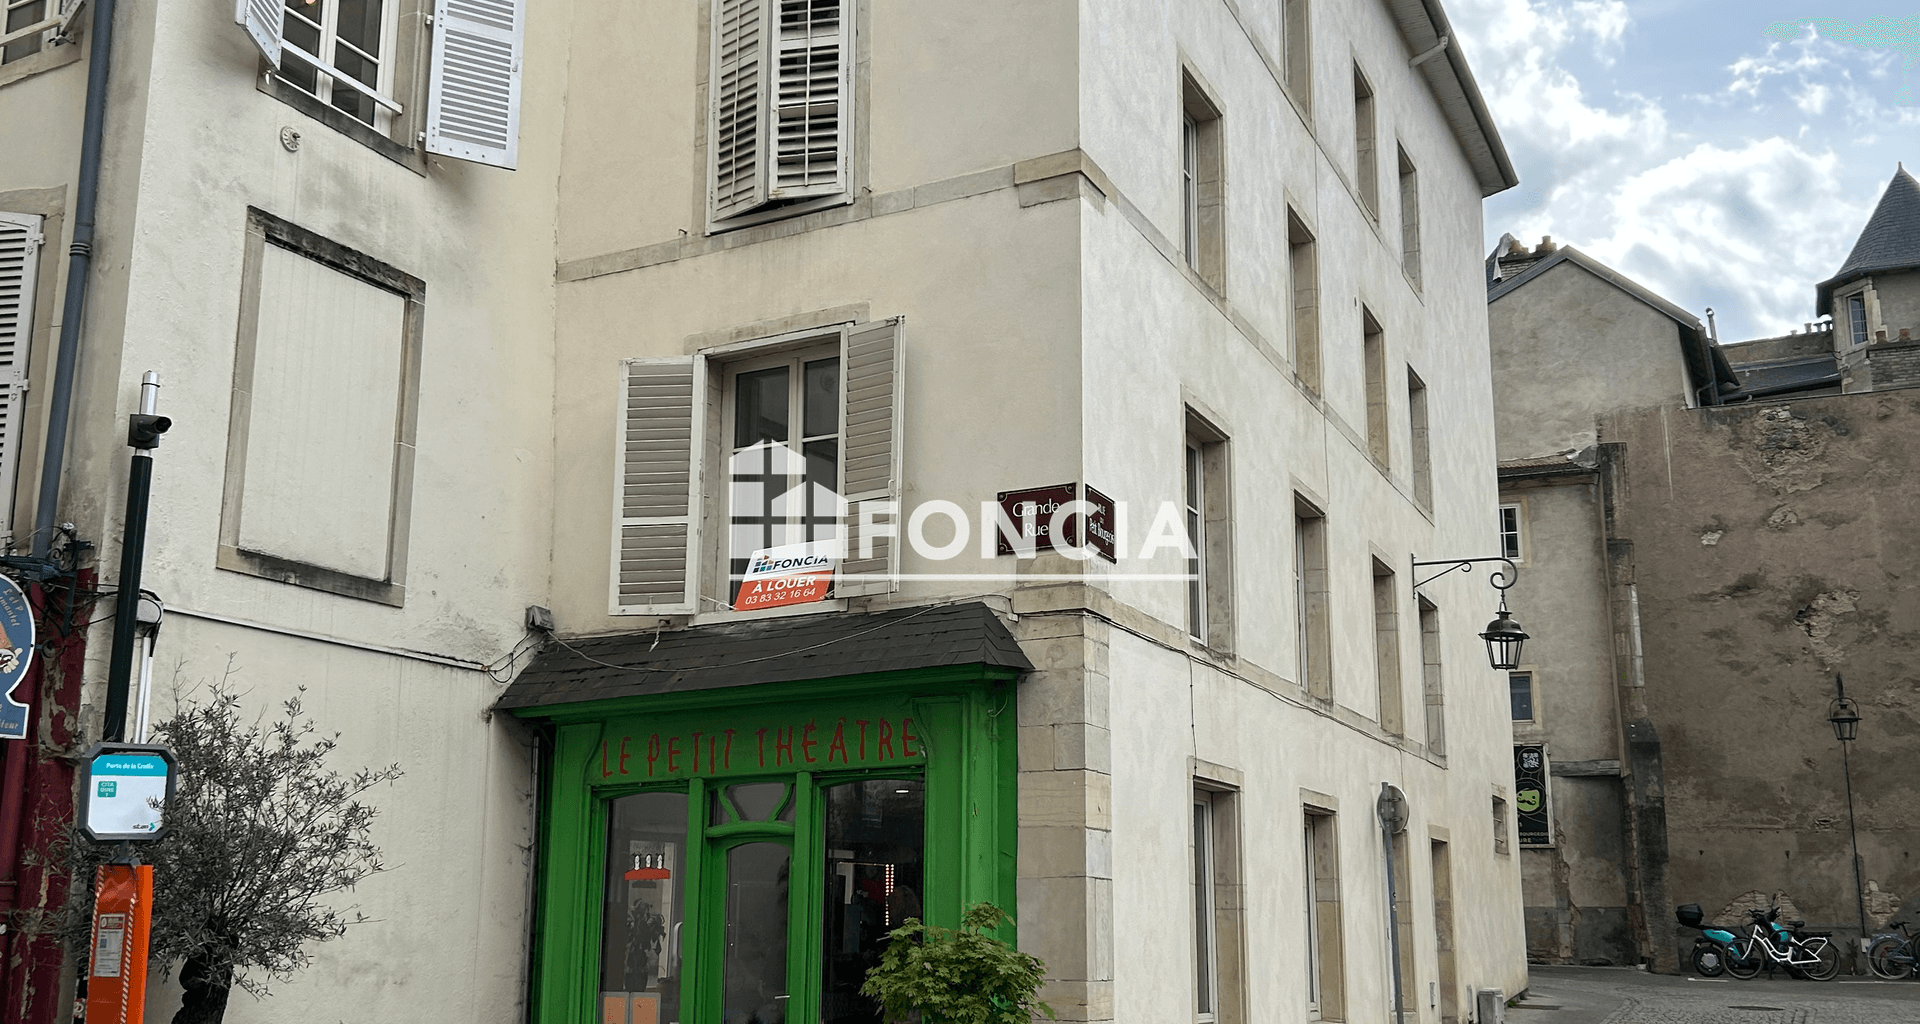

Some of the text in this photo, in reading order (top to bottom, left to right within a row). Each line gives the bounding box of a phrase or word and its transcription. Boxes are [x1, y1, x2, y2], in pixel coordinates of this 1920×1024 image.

[1012, 498, 1060, 518] Grande
[1024, 522, 1049, 537] Rue
[772, 555, 828, 570] FONCIA
[752, 576, 817, 594] À LOUER
[745, 587, 816, 605] 03 83 32 16 64
[602, 716, 918, 780] LE PETIT THÉÂTRE
